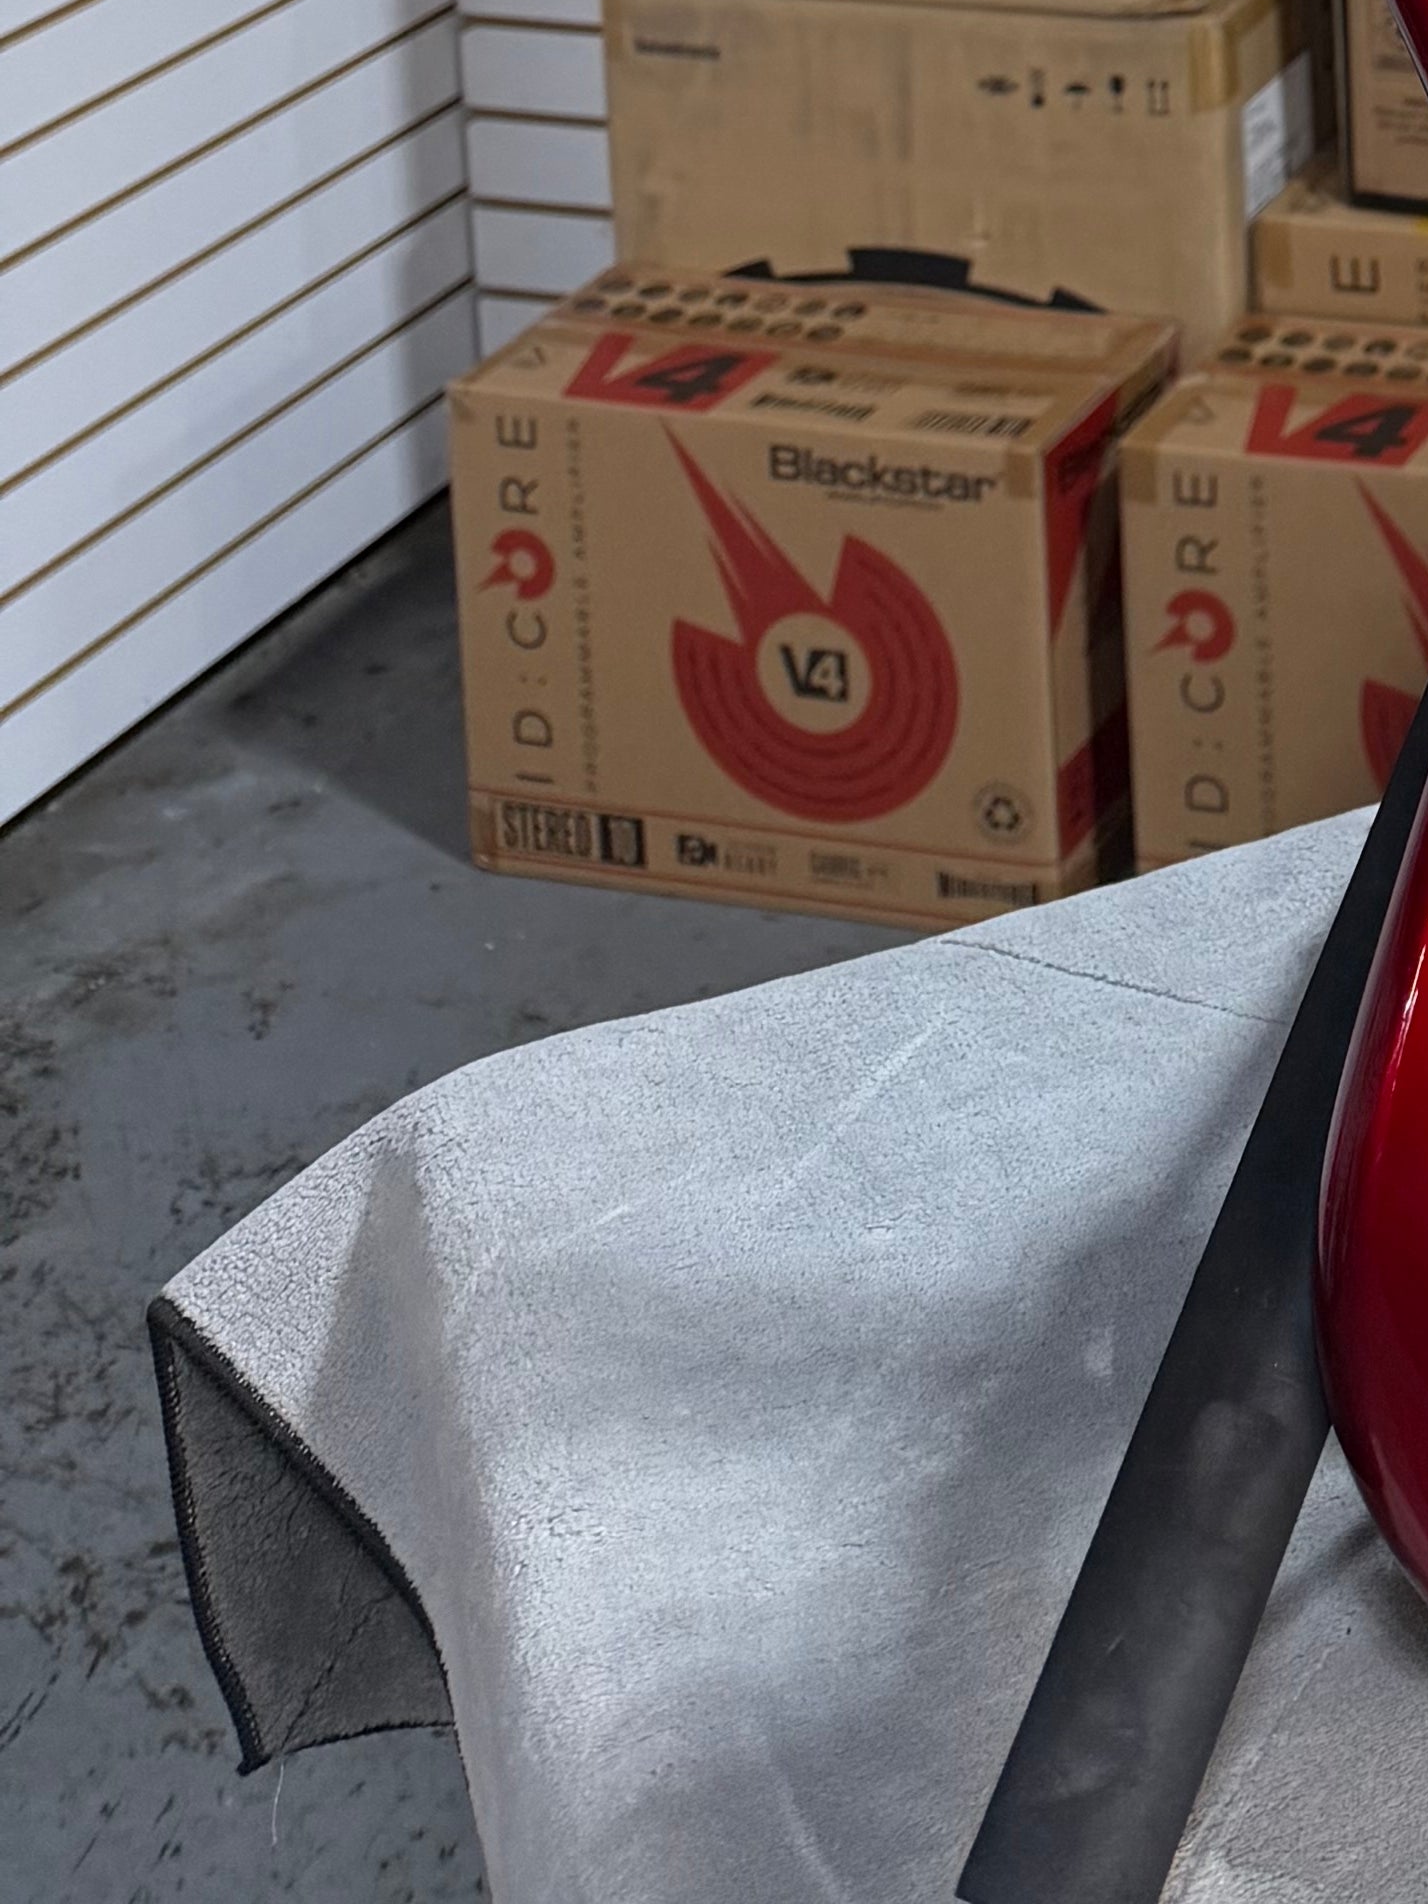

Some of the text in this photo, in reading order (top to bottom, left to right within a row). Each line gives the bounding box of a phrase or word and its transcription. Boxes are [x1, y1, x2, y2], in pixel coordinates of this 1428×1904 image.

[768, 442, 998, 502] Blackstar
[779, 642, 851, 706] V4
[502, 799, 593, 858] STEREO
